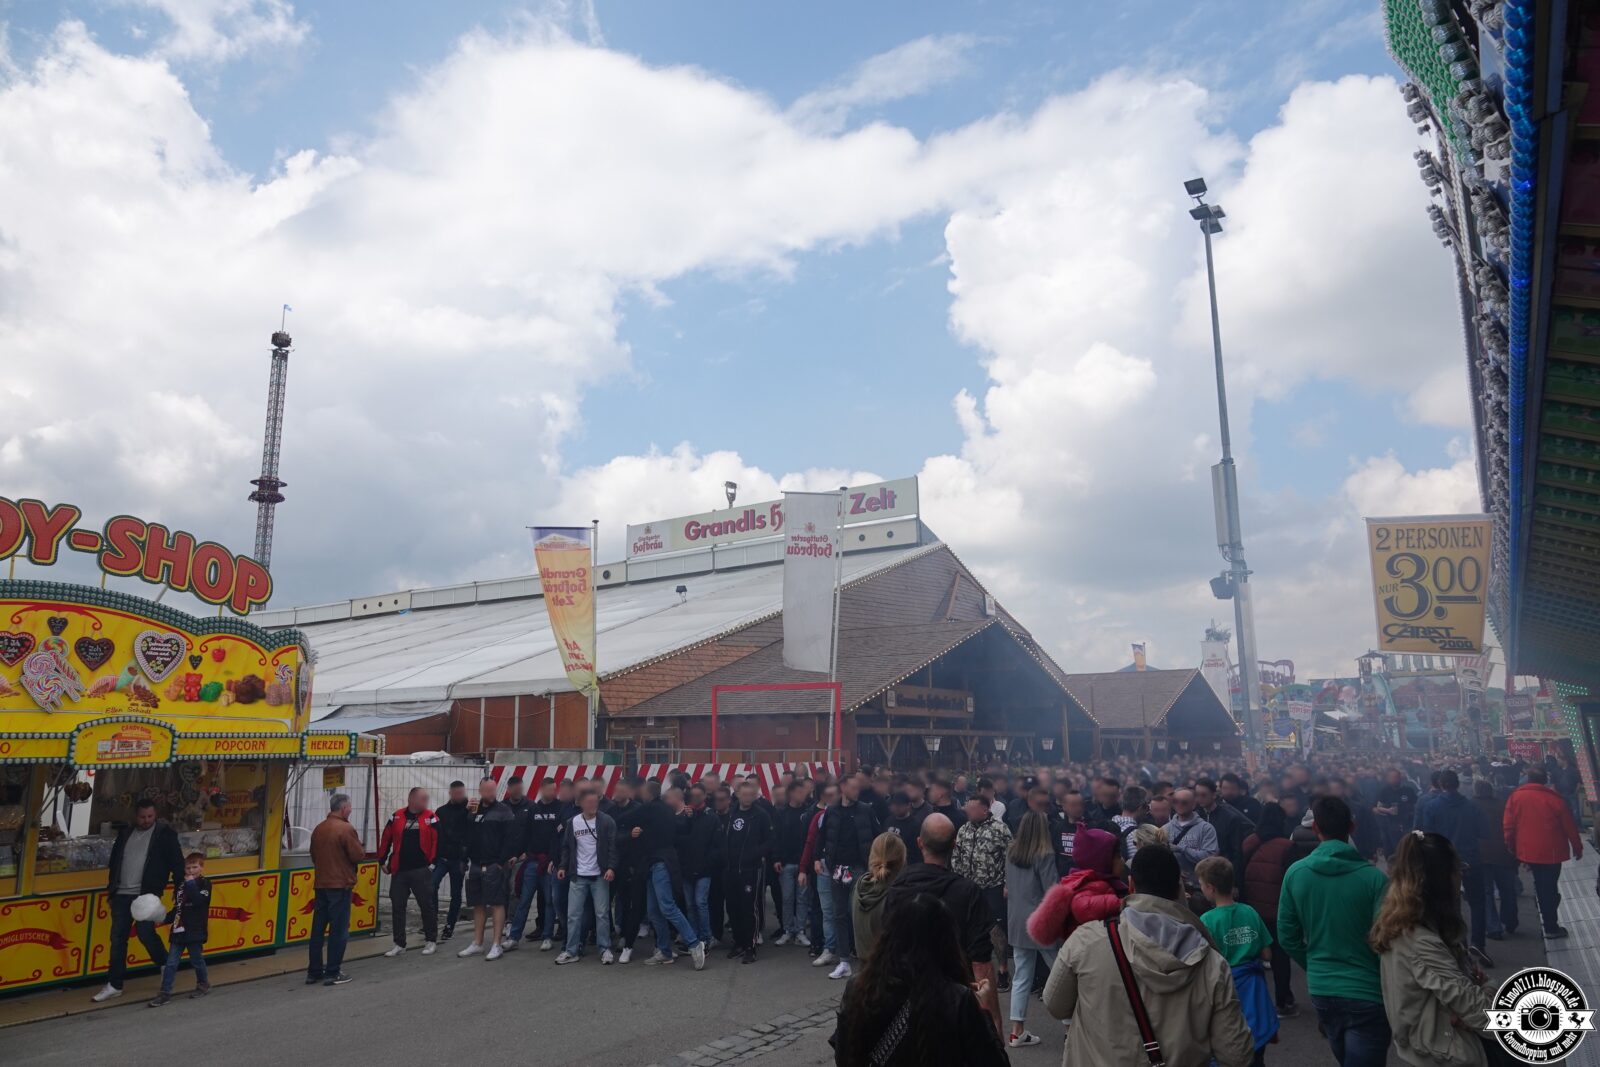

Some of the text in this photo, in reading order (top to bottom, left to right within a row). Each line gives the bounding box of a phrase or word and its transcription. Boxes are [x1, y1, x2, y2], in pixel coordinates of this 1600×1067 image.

[684, 508, 767, 541] Grandls
[849, 486, 897, 515] Zelt
[1375, 526, 1484, 551] 2 PERSONEN
[1378, 582, 1399, 594] NUR
[214, 740, 267, 752] POPCORN
[310, 740, 345, 750] HERZEN
